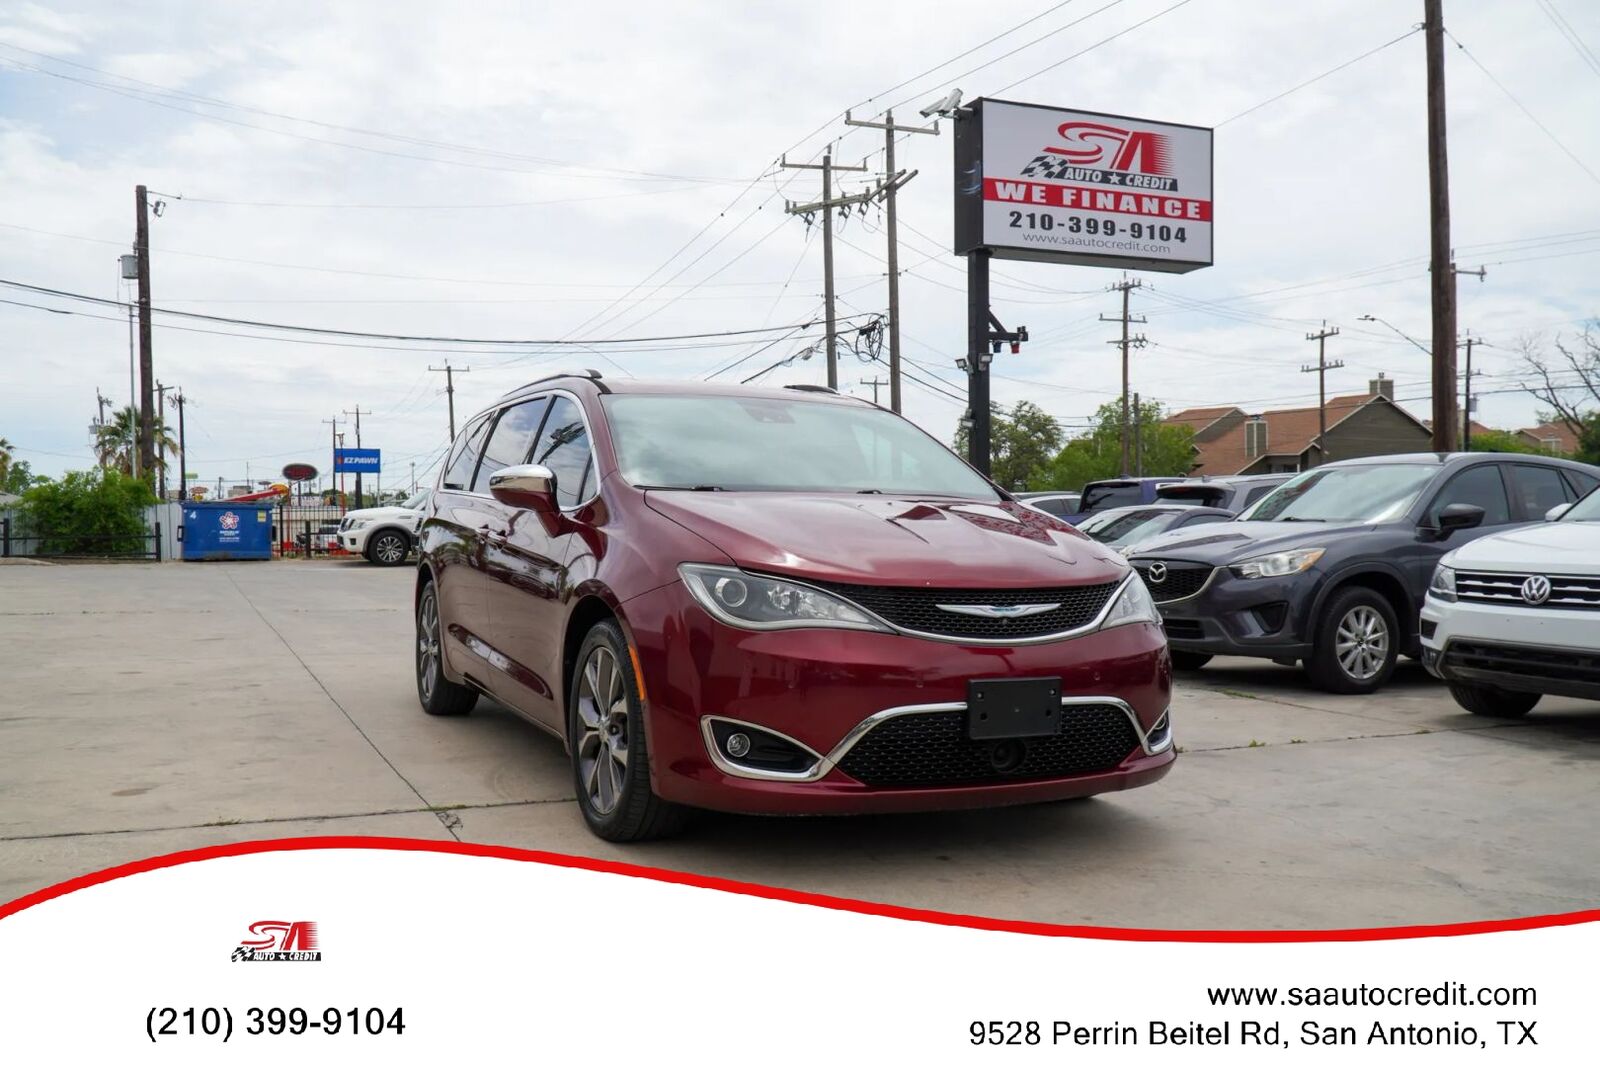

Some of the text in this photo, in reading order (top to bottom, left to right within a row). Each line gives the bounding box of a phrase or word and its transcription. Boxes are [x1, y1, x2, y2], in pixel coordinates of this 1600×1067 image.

[1042, 122, 1174, 175] SA
[1064, 168, 1173, 191] AUTO CREDIT
[995, 181, 1201, 219] WE FINANCE
[1009, 211, 1188, 243] 210-399-9104
[1023, 232, 1171, 254] www.saautocredit.com
